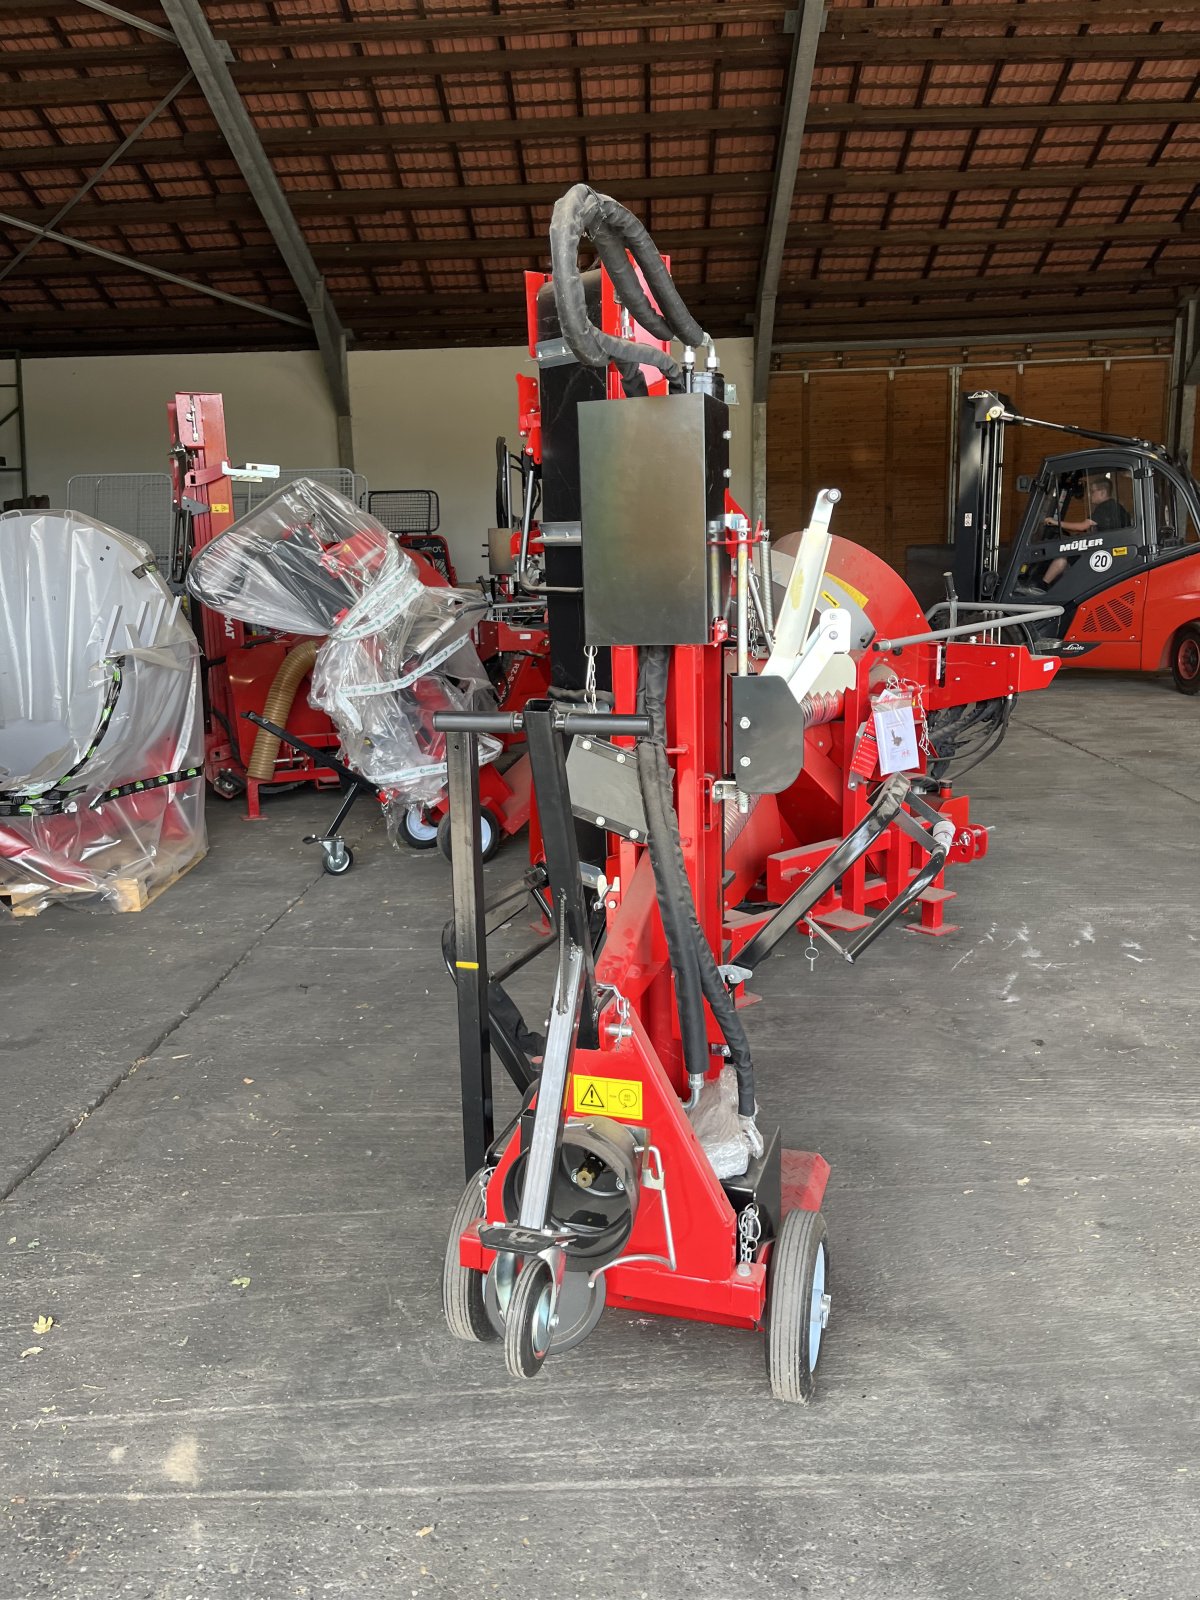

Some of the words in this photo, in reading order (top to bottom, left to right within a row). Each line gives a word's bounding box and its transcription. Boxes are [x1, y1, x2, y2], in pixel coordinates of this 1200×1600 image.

[1058, 537, 1104, 553] MÜLLER
[1093, 554, 1108, 568] 20
[1062, 642, 1085, 651] Linde
